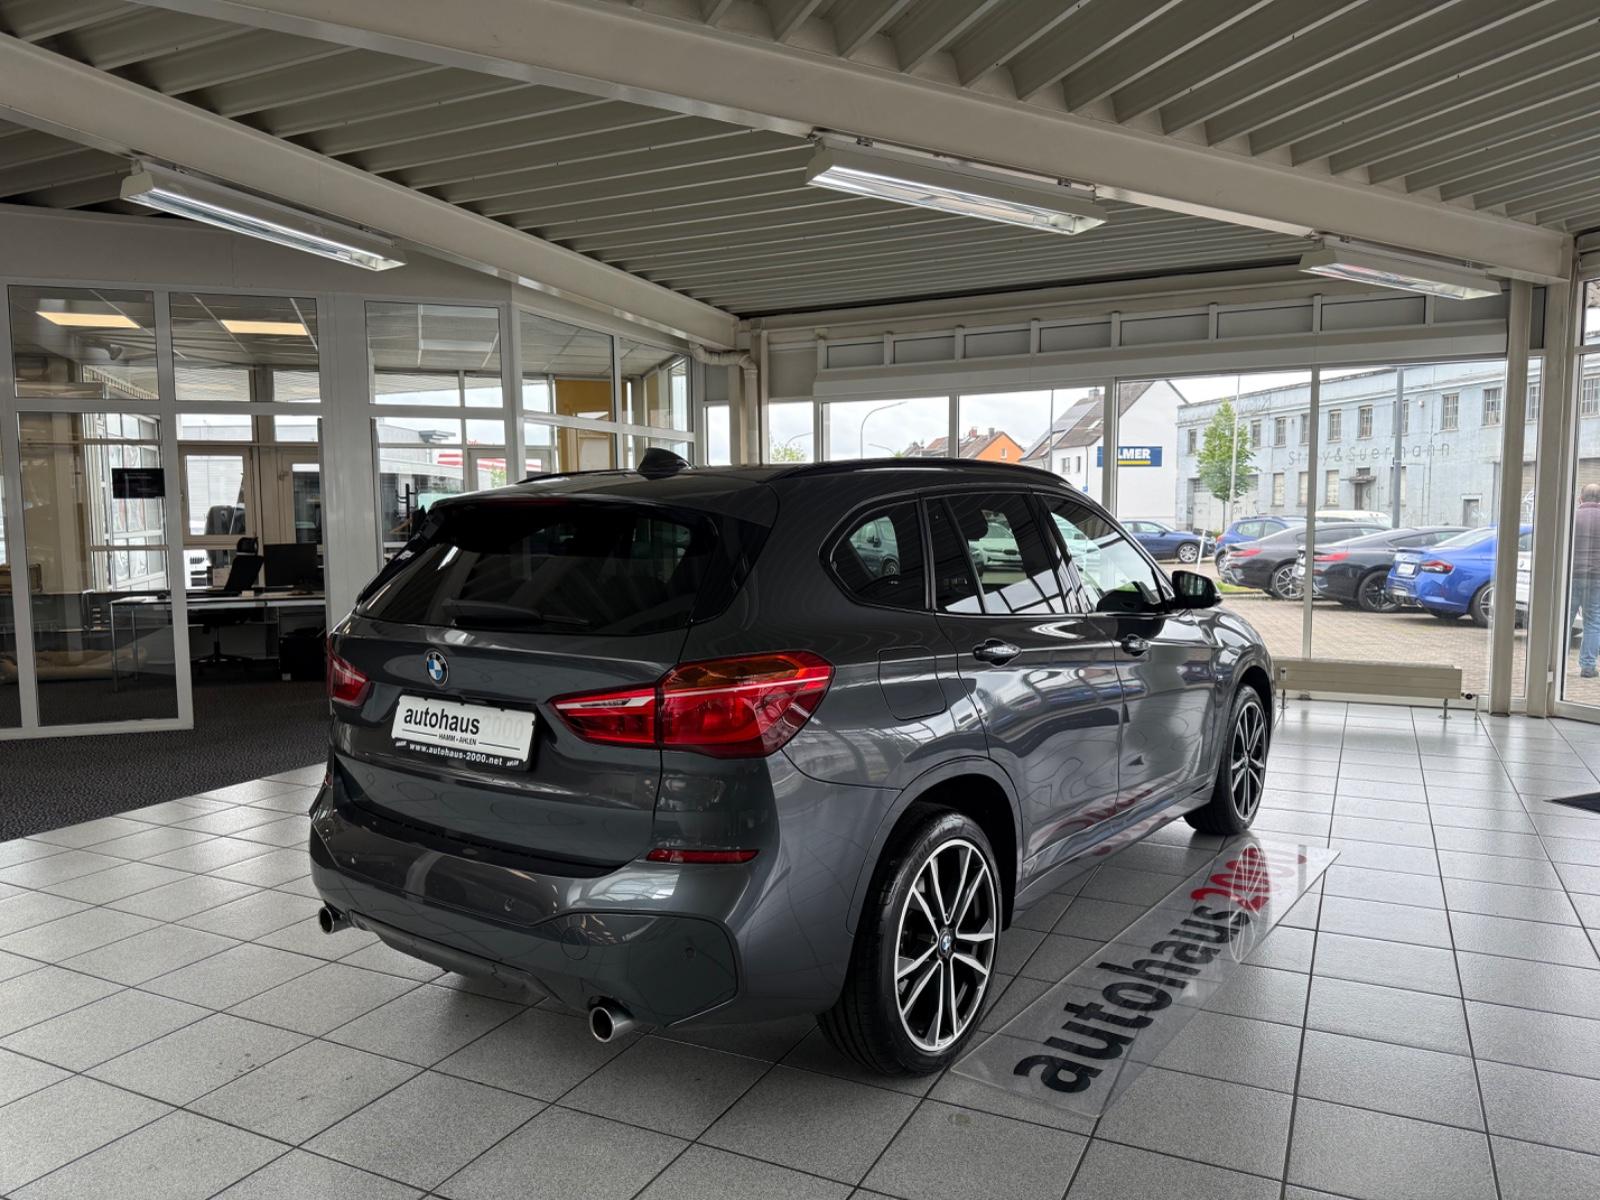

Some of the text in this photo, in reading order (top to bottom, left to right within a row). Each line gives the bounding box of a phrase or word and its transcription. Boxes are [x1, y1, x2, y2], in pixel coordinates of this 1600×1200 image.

[1117, 447, 1151, 459] LMER
[403, 707, 480, 736] autohaus
[409, 743, 503, 766] www.autohaus-2000.net
[1013, 906, 1250, 1093] autohaus
